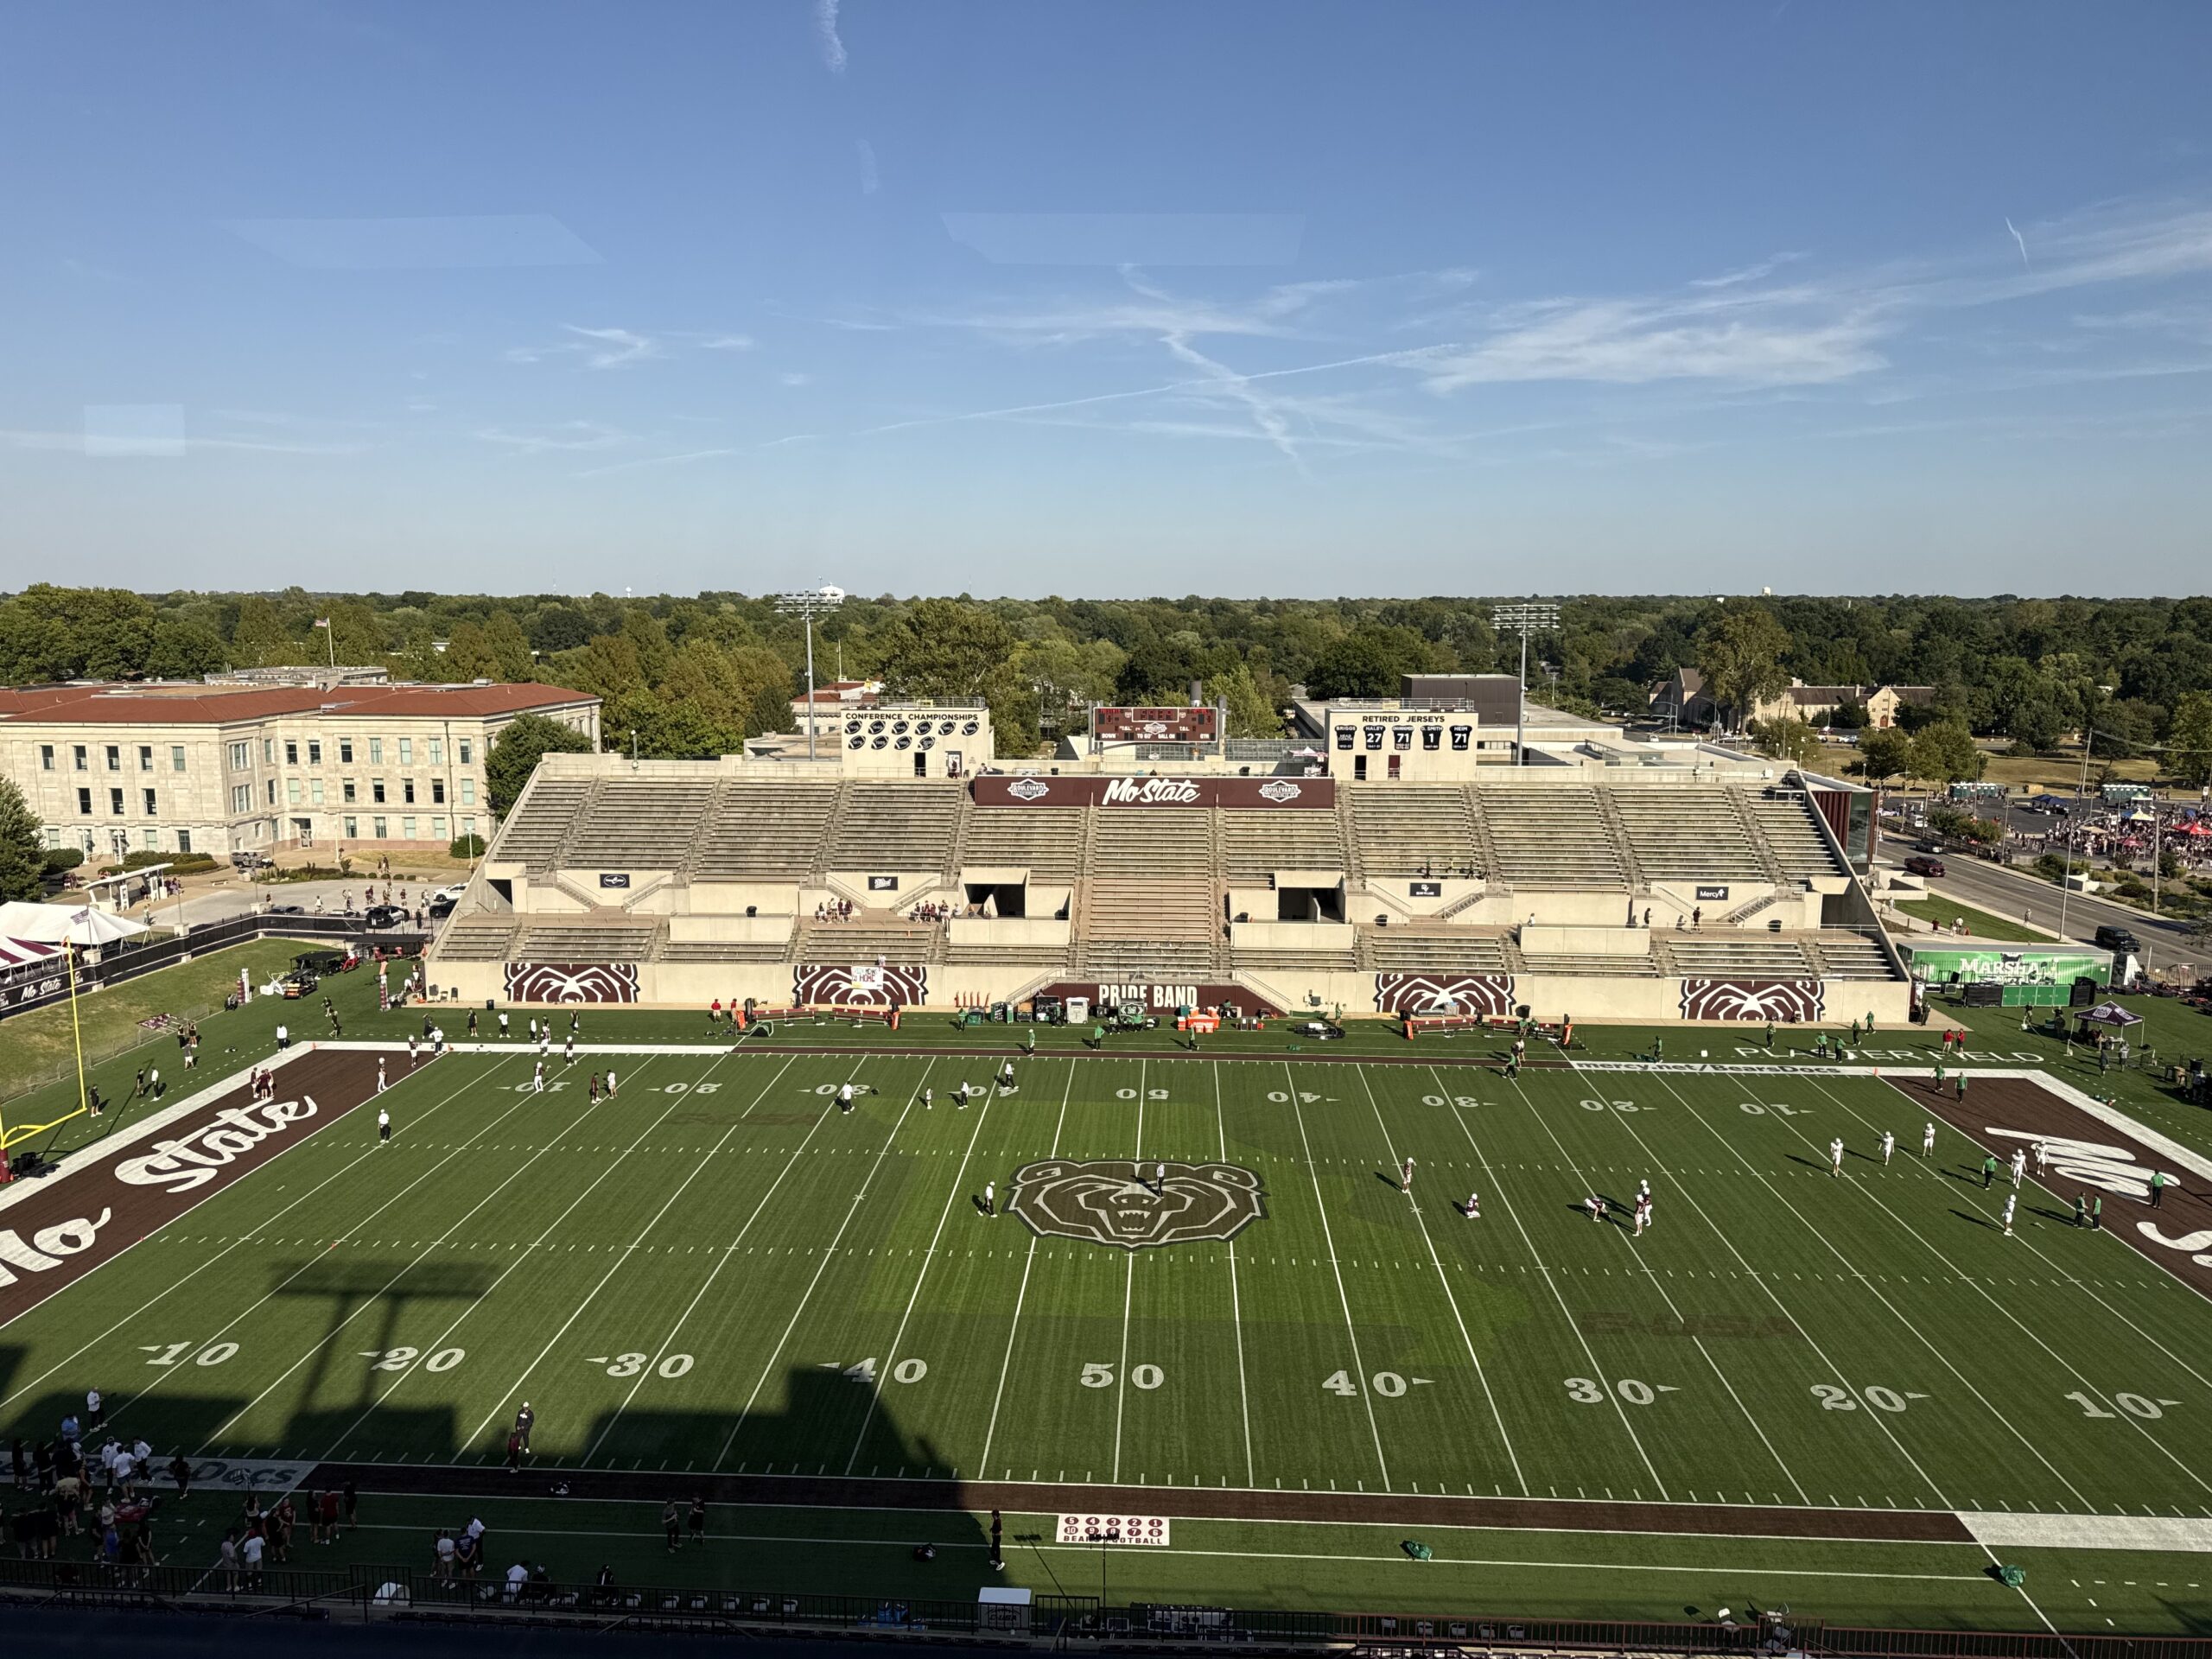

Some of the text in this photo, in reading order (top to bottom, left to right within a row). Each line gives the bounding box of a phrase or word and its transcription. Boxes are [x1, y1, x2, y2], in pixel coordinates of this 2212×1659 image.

[1366, 733, 1382, 743] 27
[1396, 733, 1409, 743] 71
[1428, 733, 1434, 743] 1
[1454, 733, 1467, 743] 71
[1013, 785, 1044, 793] BOULEVARD
[1264, 786, 1296, 796] BOULEVARD
[1700, 890, 1719, 899] Mercy
[21, 977, 62, 1001] Mo State
[1098, 984, 1198, 1007] PRIDE BAND
[1575, 1060, 1841, 1074] mercy.net/BearsDocs
[114, 1095, 319, 1193] State
